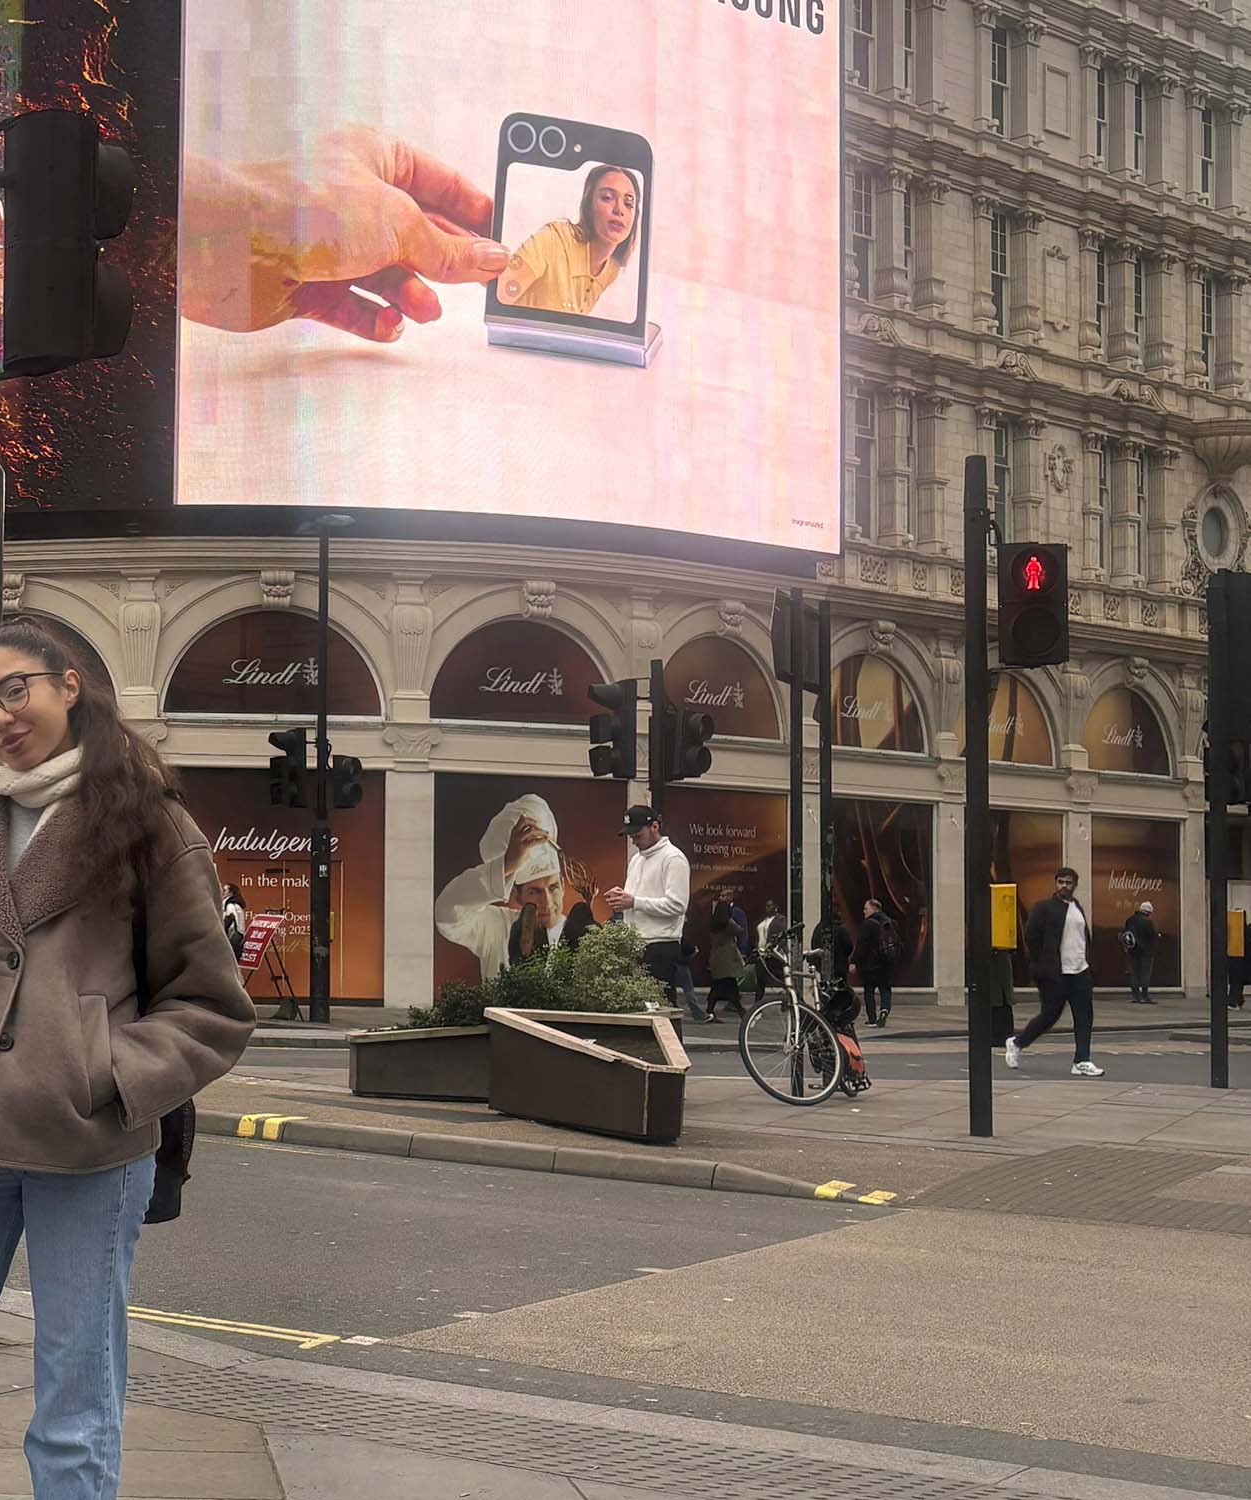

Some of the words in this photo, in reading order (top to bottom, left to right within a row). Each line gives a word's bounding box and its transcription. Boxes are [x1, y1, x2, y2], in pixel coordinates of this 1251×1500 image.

[222, 659, 302, 685] Lindt
[479, 666, 547, 694] Lindt
[685, 679, 733, 706] Lindt
[840, 695, 882, 720] Lindt
[988, 714, 1015, 736] indt
[1102, 723, 1135, 747] Lindt
[689, 824, 704, 836] We
[705, 823, 724, 837] look
[726, 825, 757, 838] forward
[214, 826, 339, 860] Indulgene
[693, 842, 702, 853] to
[703, 843, 730, 857] seeing
[241, 875, 253, 886] in
[257, 874, 278, 887] the
[282, 875, 310, 887] mak
[1108, 869, 1163, 897] Indulgence
[284, 911, 310, 923] Open
